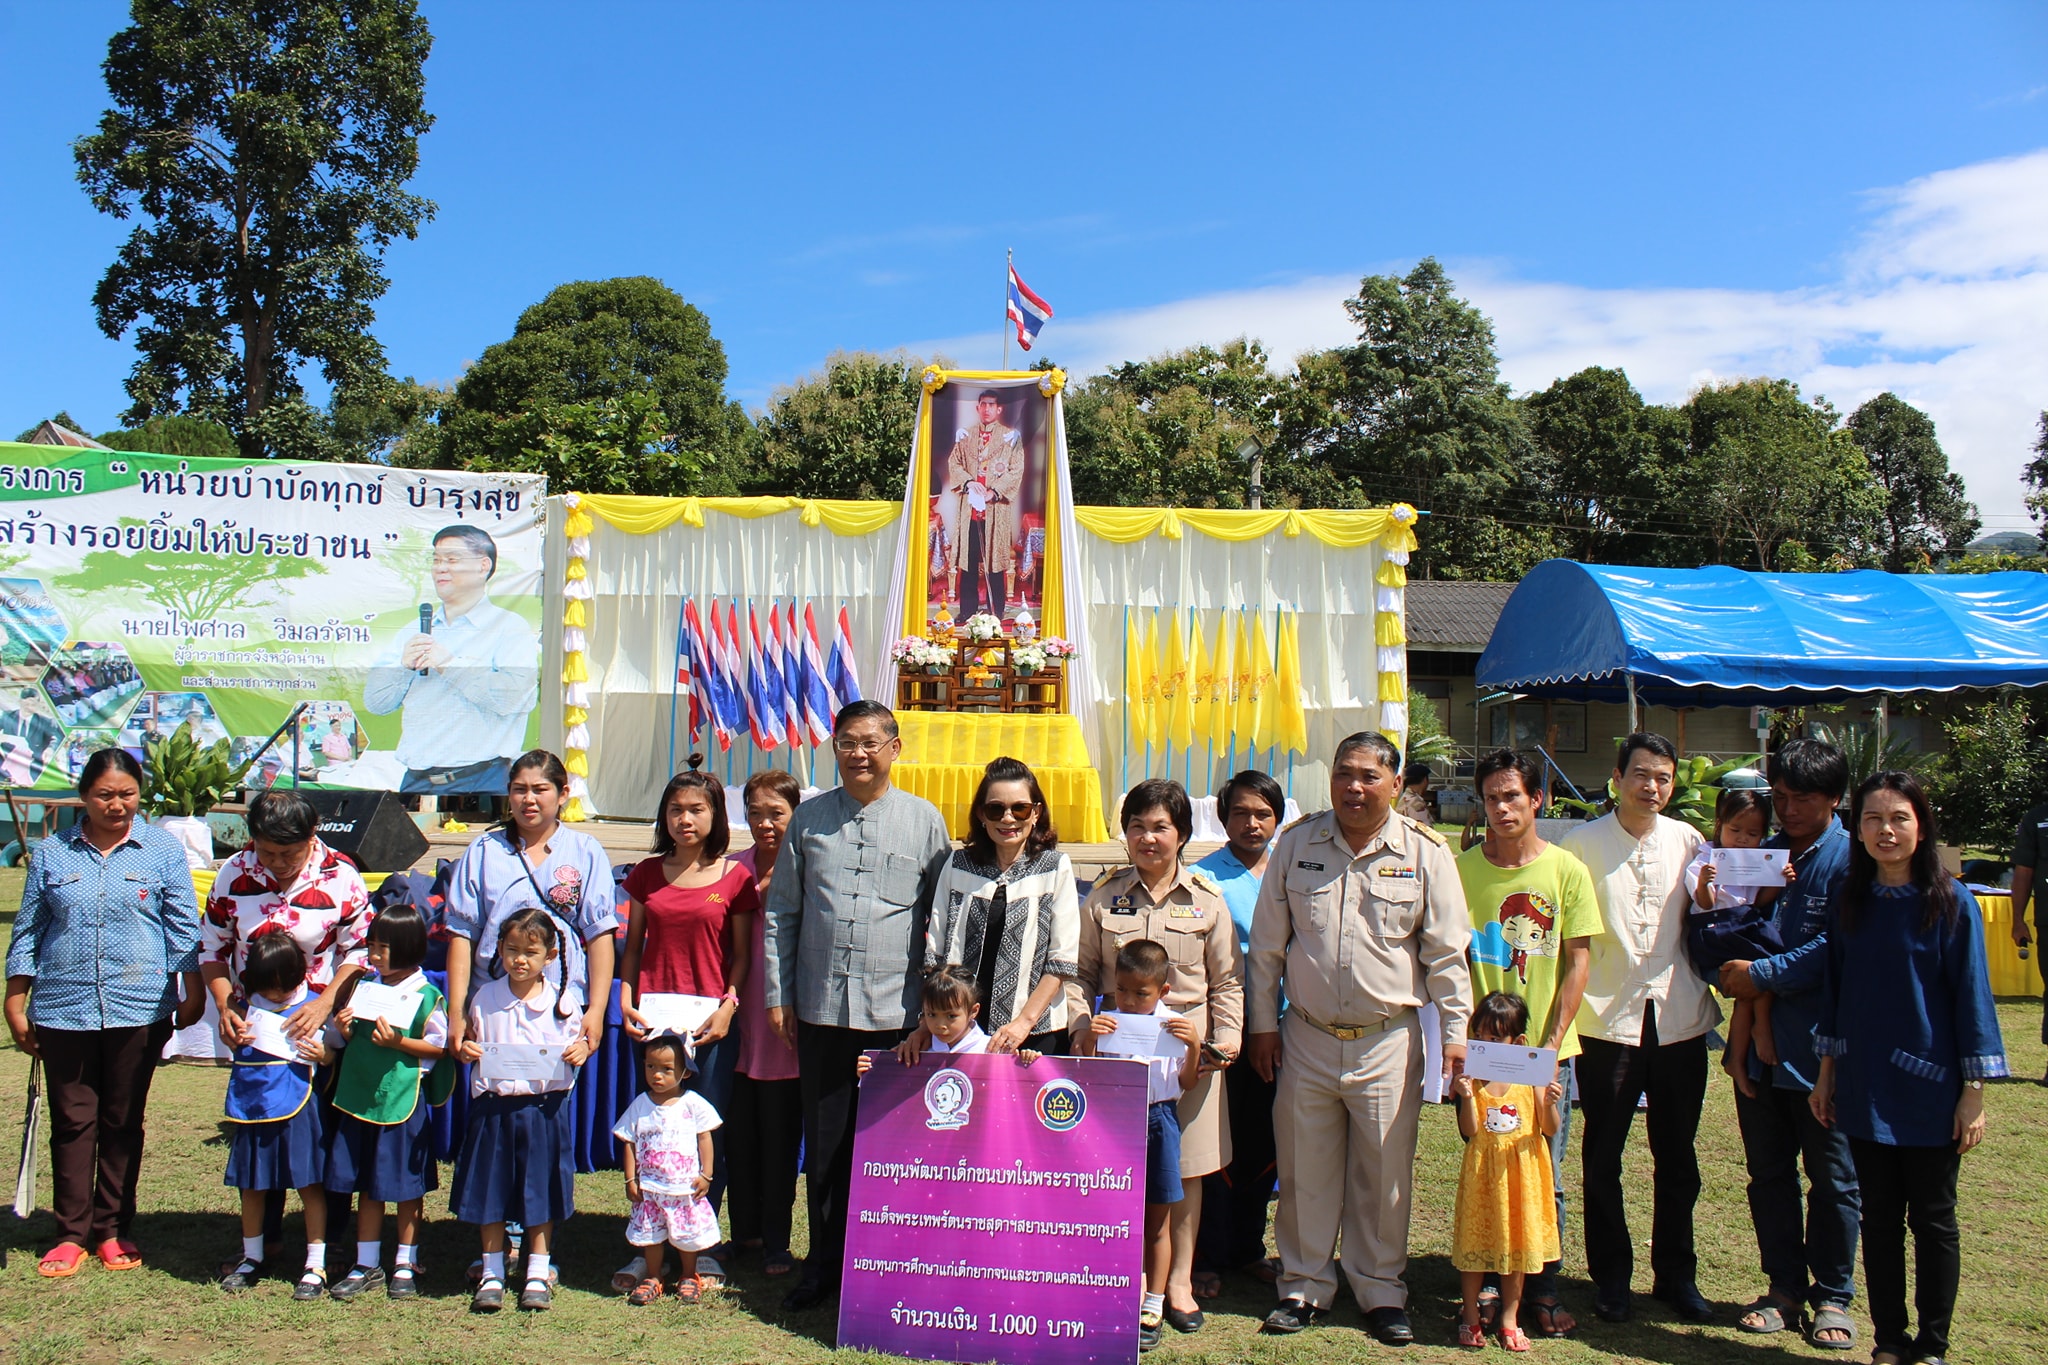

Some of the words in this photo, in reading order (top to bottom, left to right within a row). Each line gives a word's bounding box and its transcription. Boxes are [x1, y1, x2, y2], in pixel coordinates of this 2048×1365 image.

[140, 463, 388, 511] หน่วยบำบัดทุกข์
[407, 478, 520, 520] บำรุงสุข
[122, 610, 245, 638] นายไพศาล
[274, 613, 375, 642] วิมลรัตน์
[173, 646, 326, 666] ผู้ว่าราชการจังหวัดน่าน
[182, 672, 317, 692] และส่วนราชการทุกส่วน
[863, 1158, 1133, 1195] กองทุนพัฒนาเด็กชนบทในพระราชูปถัมภ์
[890, 1301, 978, 1331] จำนวนเงิน
[988, 1313, 1038, 1336] 1,000
[1047, 1319, 1085, 1338] บาท
